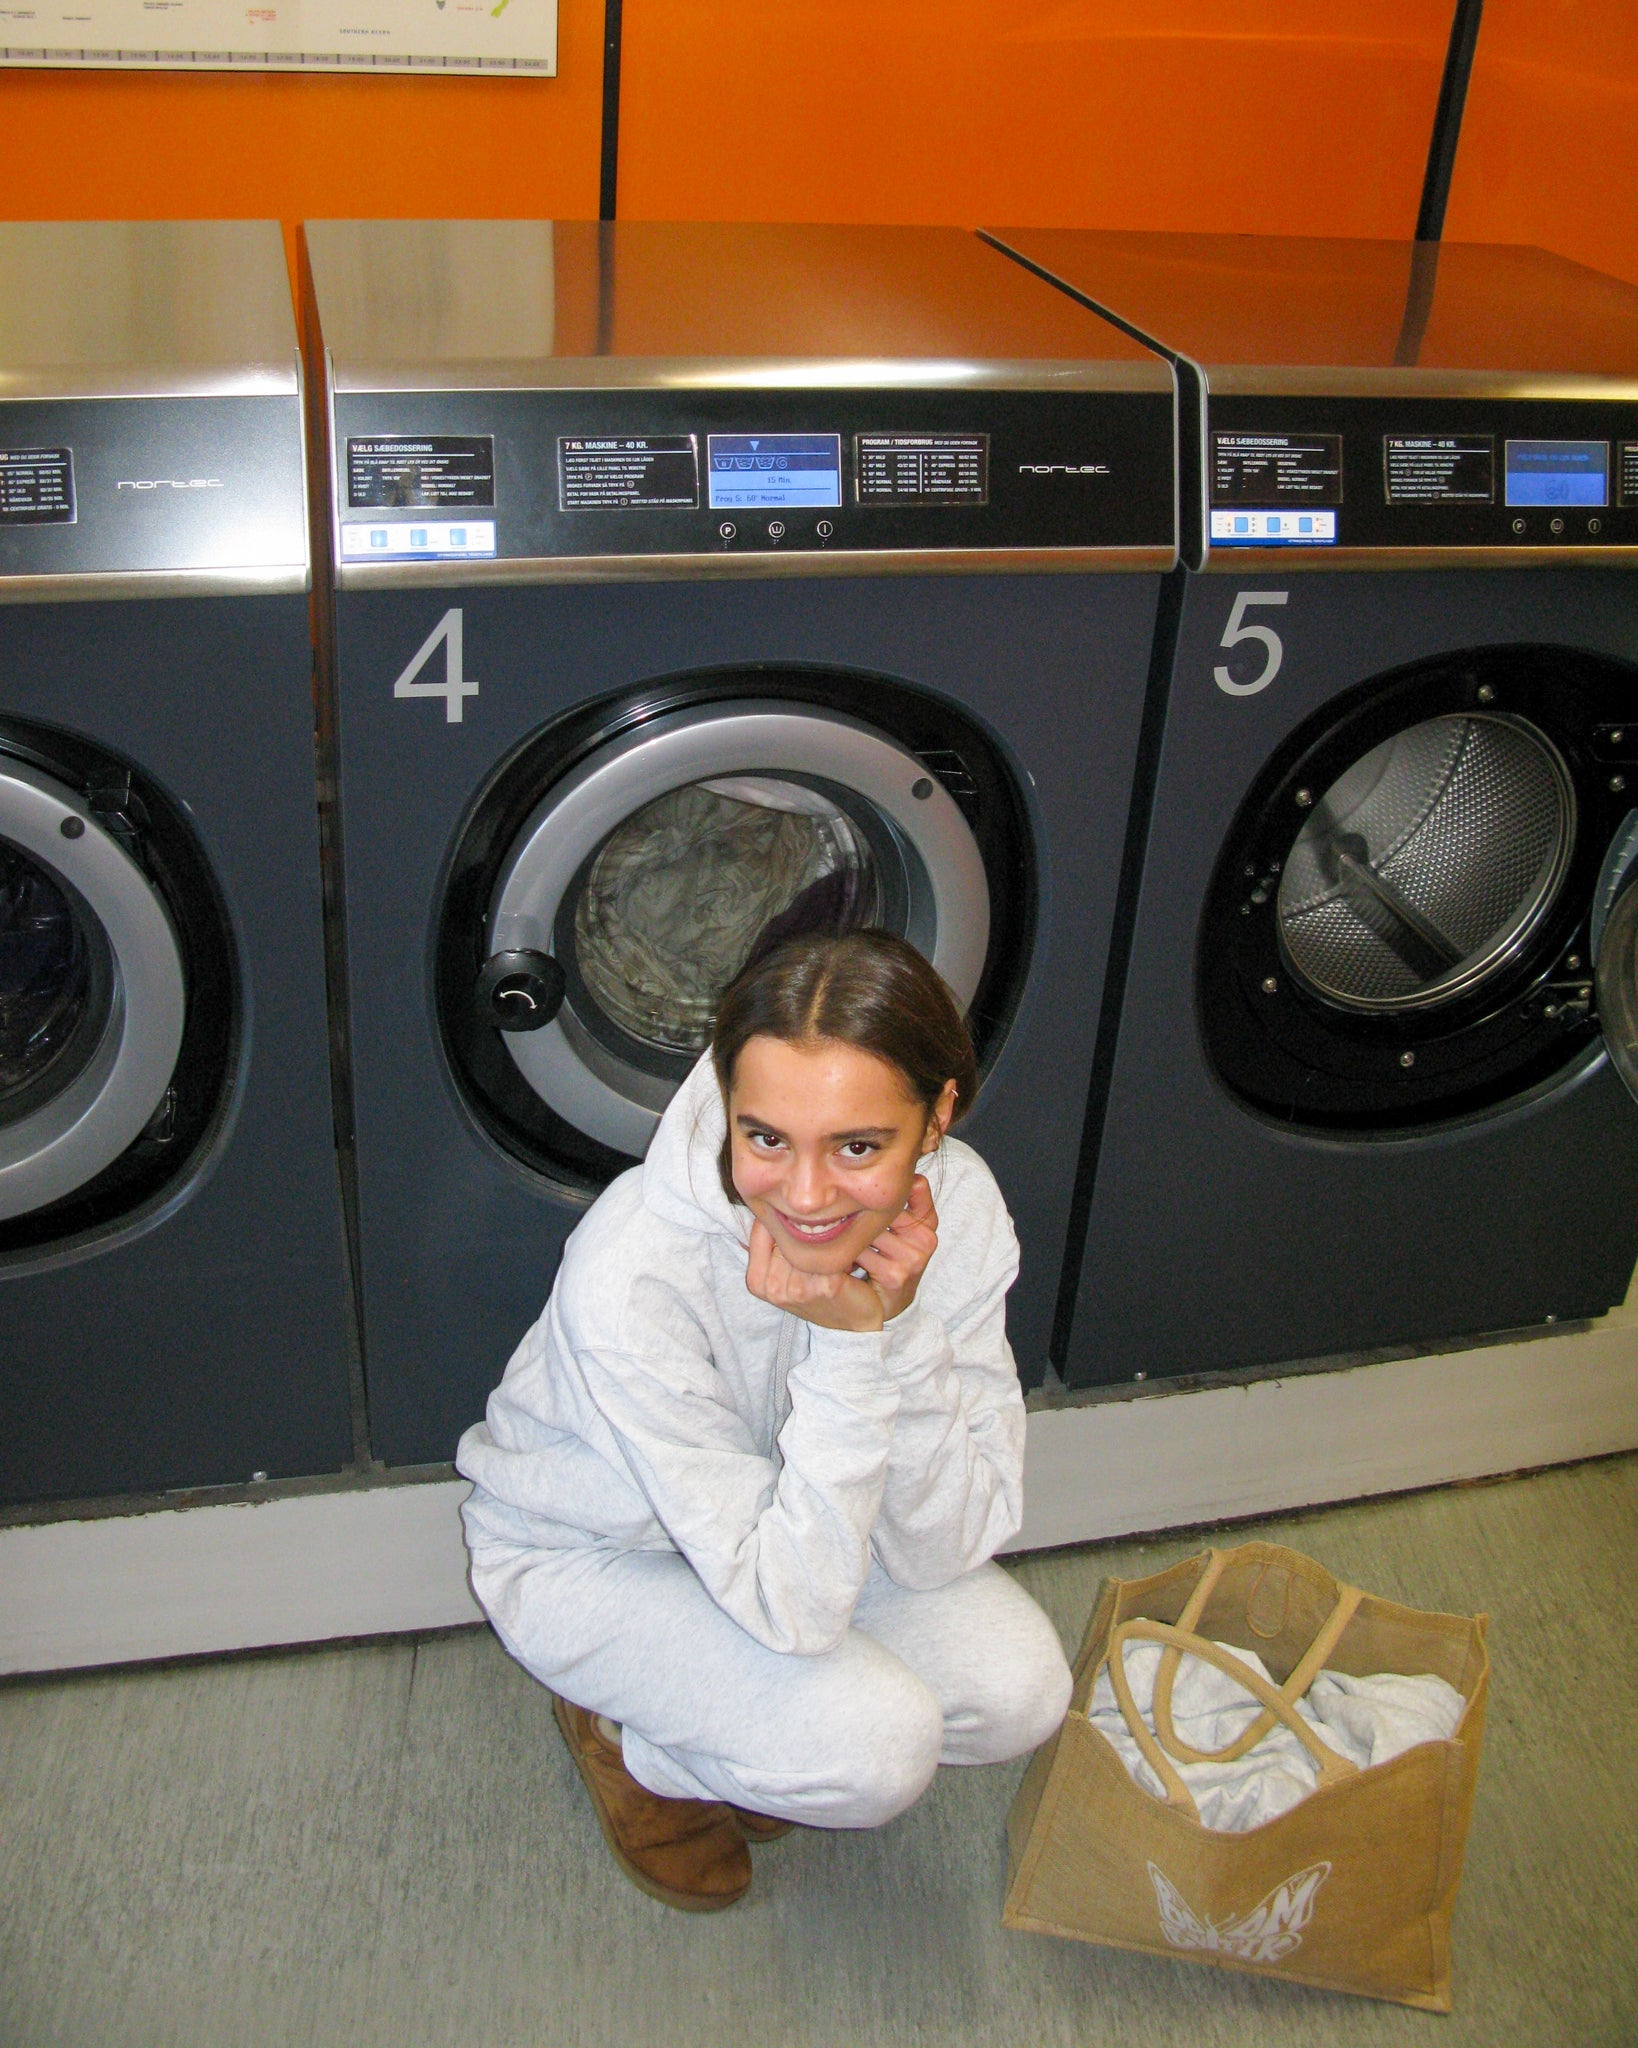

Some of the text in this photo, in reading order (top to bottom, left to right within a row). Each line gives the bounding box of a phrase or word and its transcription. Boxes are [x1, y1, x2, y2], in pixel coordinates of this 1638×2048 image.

[565, 442, 571, 450] 7
[571, 442, 584, 450] KG.
[585, 441, 618, 450] MASKINE
[626, 441, 636, 449] 40
[636, 441, 650, 449] KR.
[862, 438, 890, 446] PROGRAM
[895, 438, 933, 446] TIDSFORBRUG
[1217, 437, 1289, 446] VÆLG SÆBEDOSSERING
[352, 444, 433, 452] VÆLG SÆBEDOSSERING
[1018, 464, 1110, 474] nortec
[117, 478, 225, 490] nortec
[767, 476, 777, 484] 15
[761, 493, 787, 502] Normal
[1213, 591, 1289, 697] 5
[394, 608, 479, 723] 4
